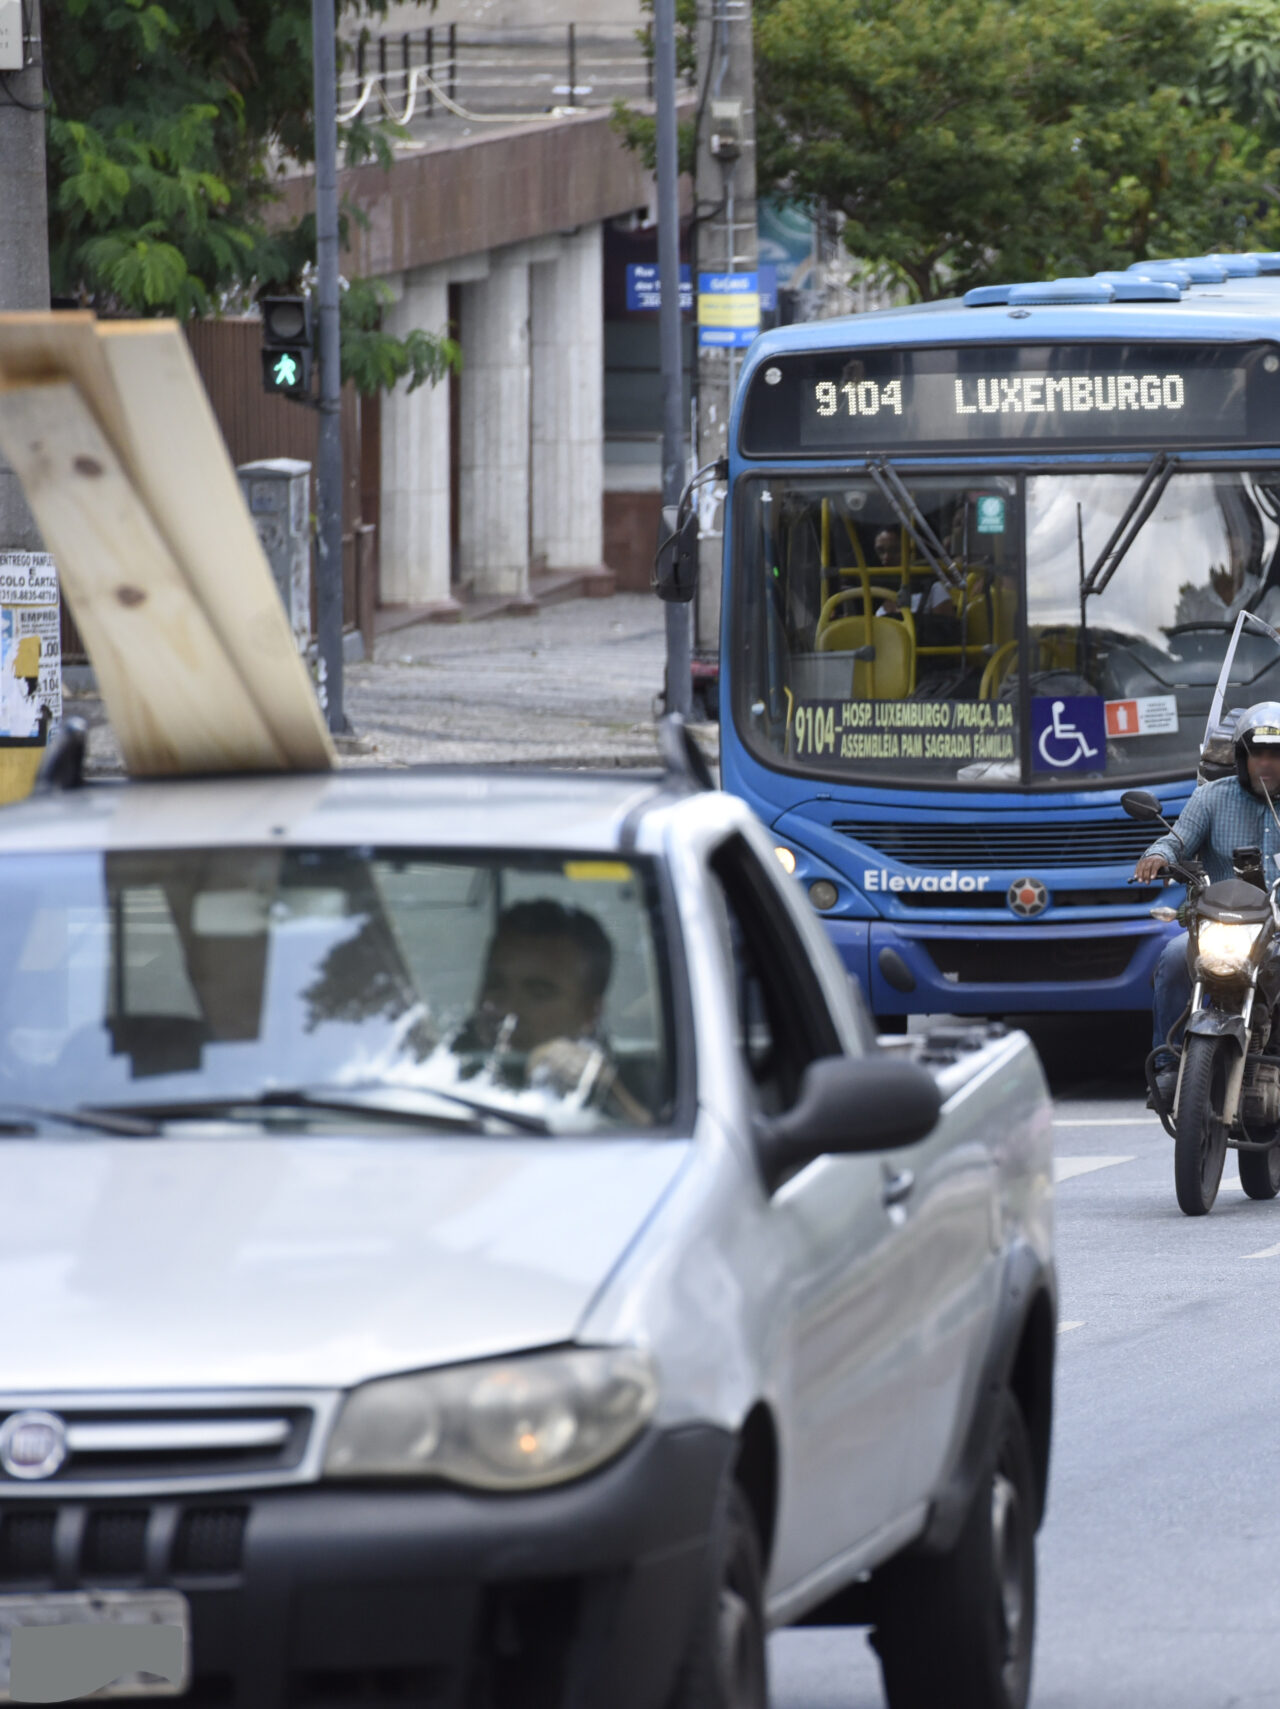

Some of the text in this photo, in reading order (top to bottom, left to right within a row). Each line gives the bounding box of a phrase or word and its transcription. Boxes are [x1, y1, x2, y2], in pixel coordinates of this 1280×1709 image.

[816, 374, 1185, 416] 9104 LUXEMBURGO
[842, 703, 872, 727] HOSP.
[875, 703, 949, 728] LUXEMBURGO
[997, 703, 1013, 727] DA
[901, 734, 922, 758] PAM
[924, 733, 971, 758] SAGRADA
[864, 869, 990, 892] Elevador
